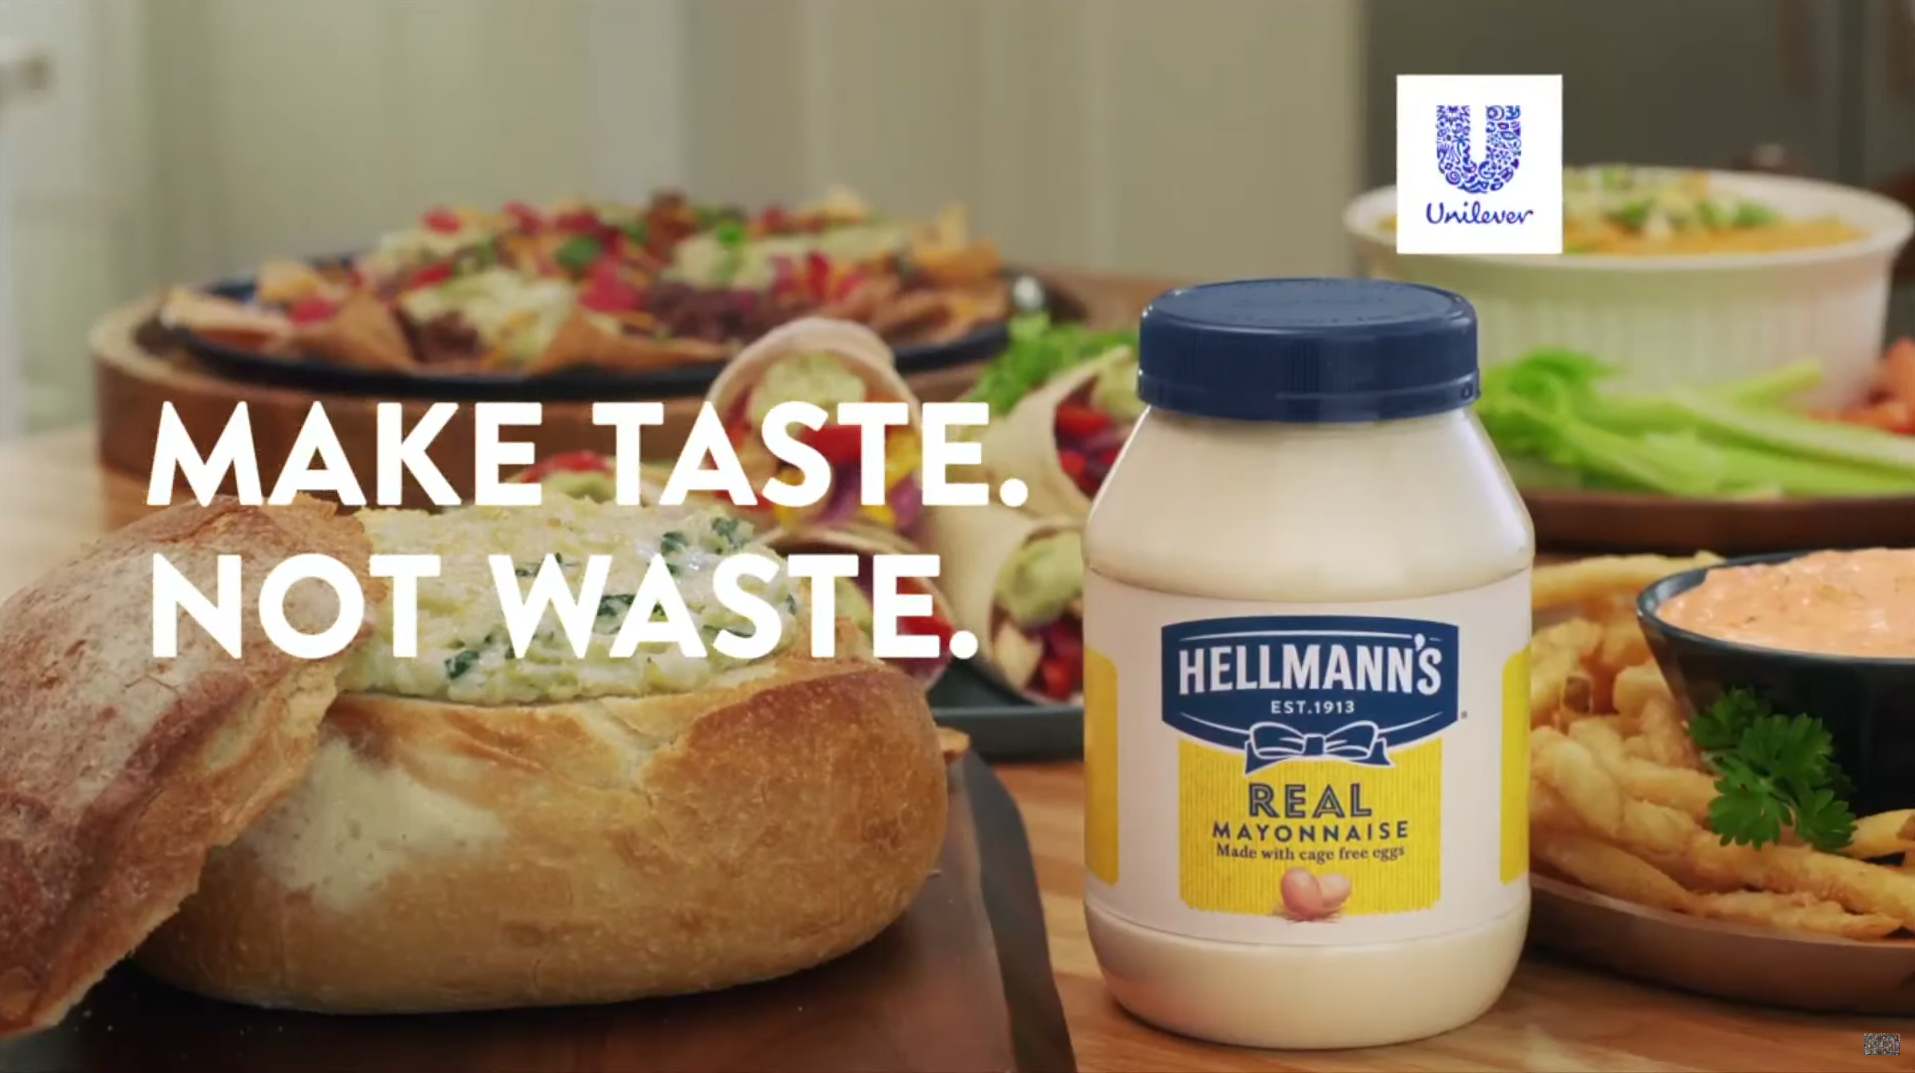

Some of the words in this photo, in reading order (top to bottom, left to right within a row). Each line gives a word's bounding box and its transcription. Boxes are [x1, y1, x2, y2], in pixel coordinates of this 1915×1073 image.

[1178, 633, 1442, 696] HELLMANN'S
[1247, 783, 1372, 819] REAL
[1212, 821, 1409, 842] MAYONNAISE
[1215, 843, 1258, 860] Made
[1260, 844, 1296, 861] with
[1299, 848, 1336, 866] cage
[1339, 844, 1370, 860] free
[1372, 845, 1406, 862] eggs
